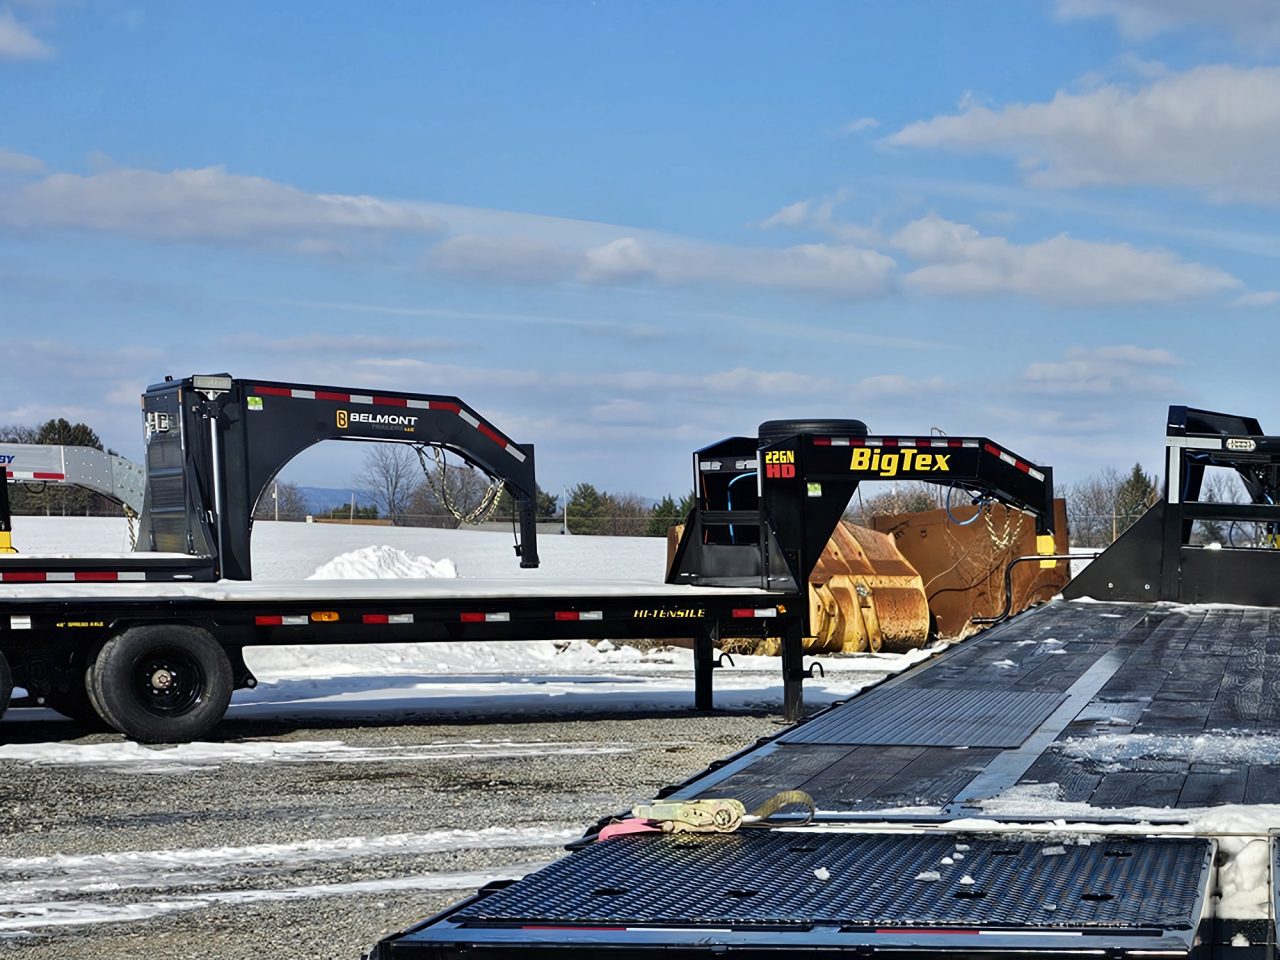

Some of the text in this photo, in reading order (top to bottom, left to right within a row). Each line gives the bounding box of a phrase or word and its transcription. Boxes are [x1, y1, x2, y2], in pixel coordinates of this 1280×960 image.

[349, 412, 418, 426] BELMONT
[850, 448, 951, 477] BigTex
[766, 464, 796, 478] HD
[633, 609, 705, 618] HI-TENSILE
